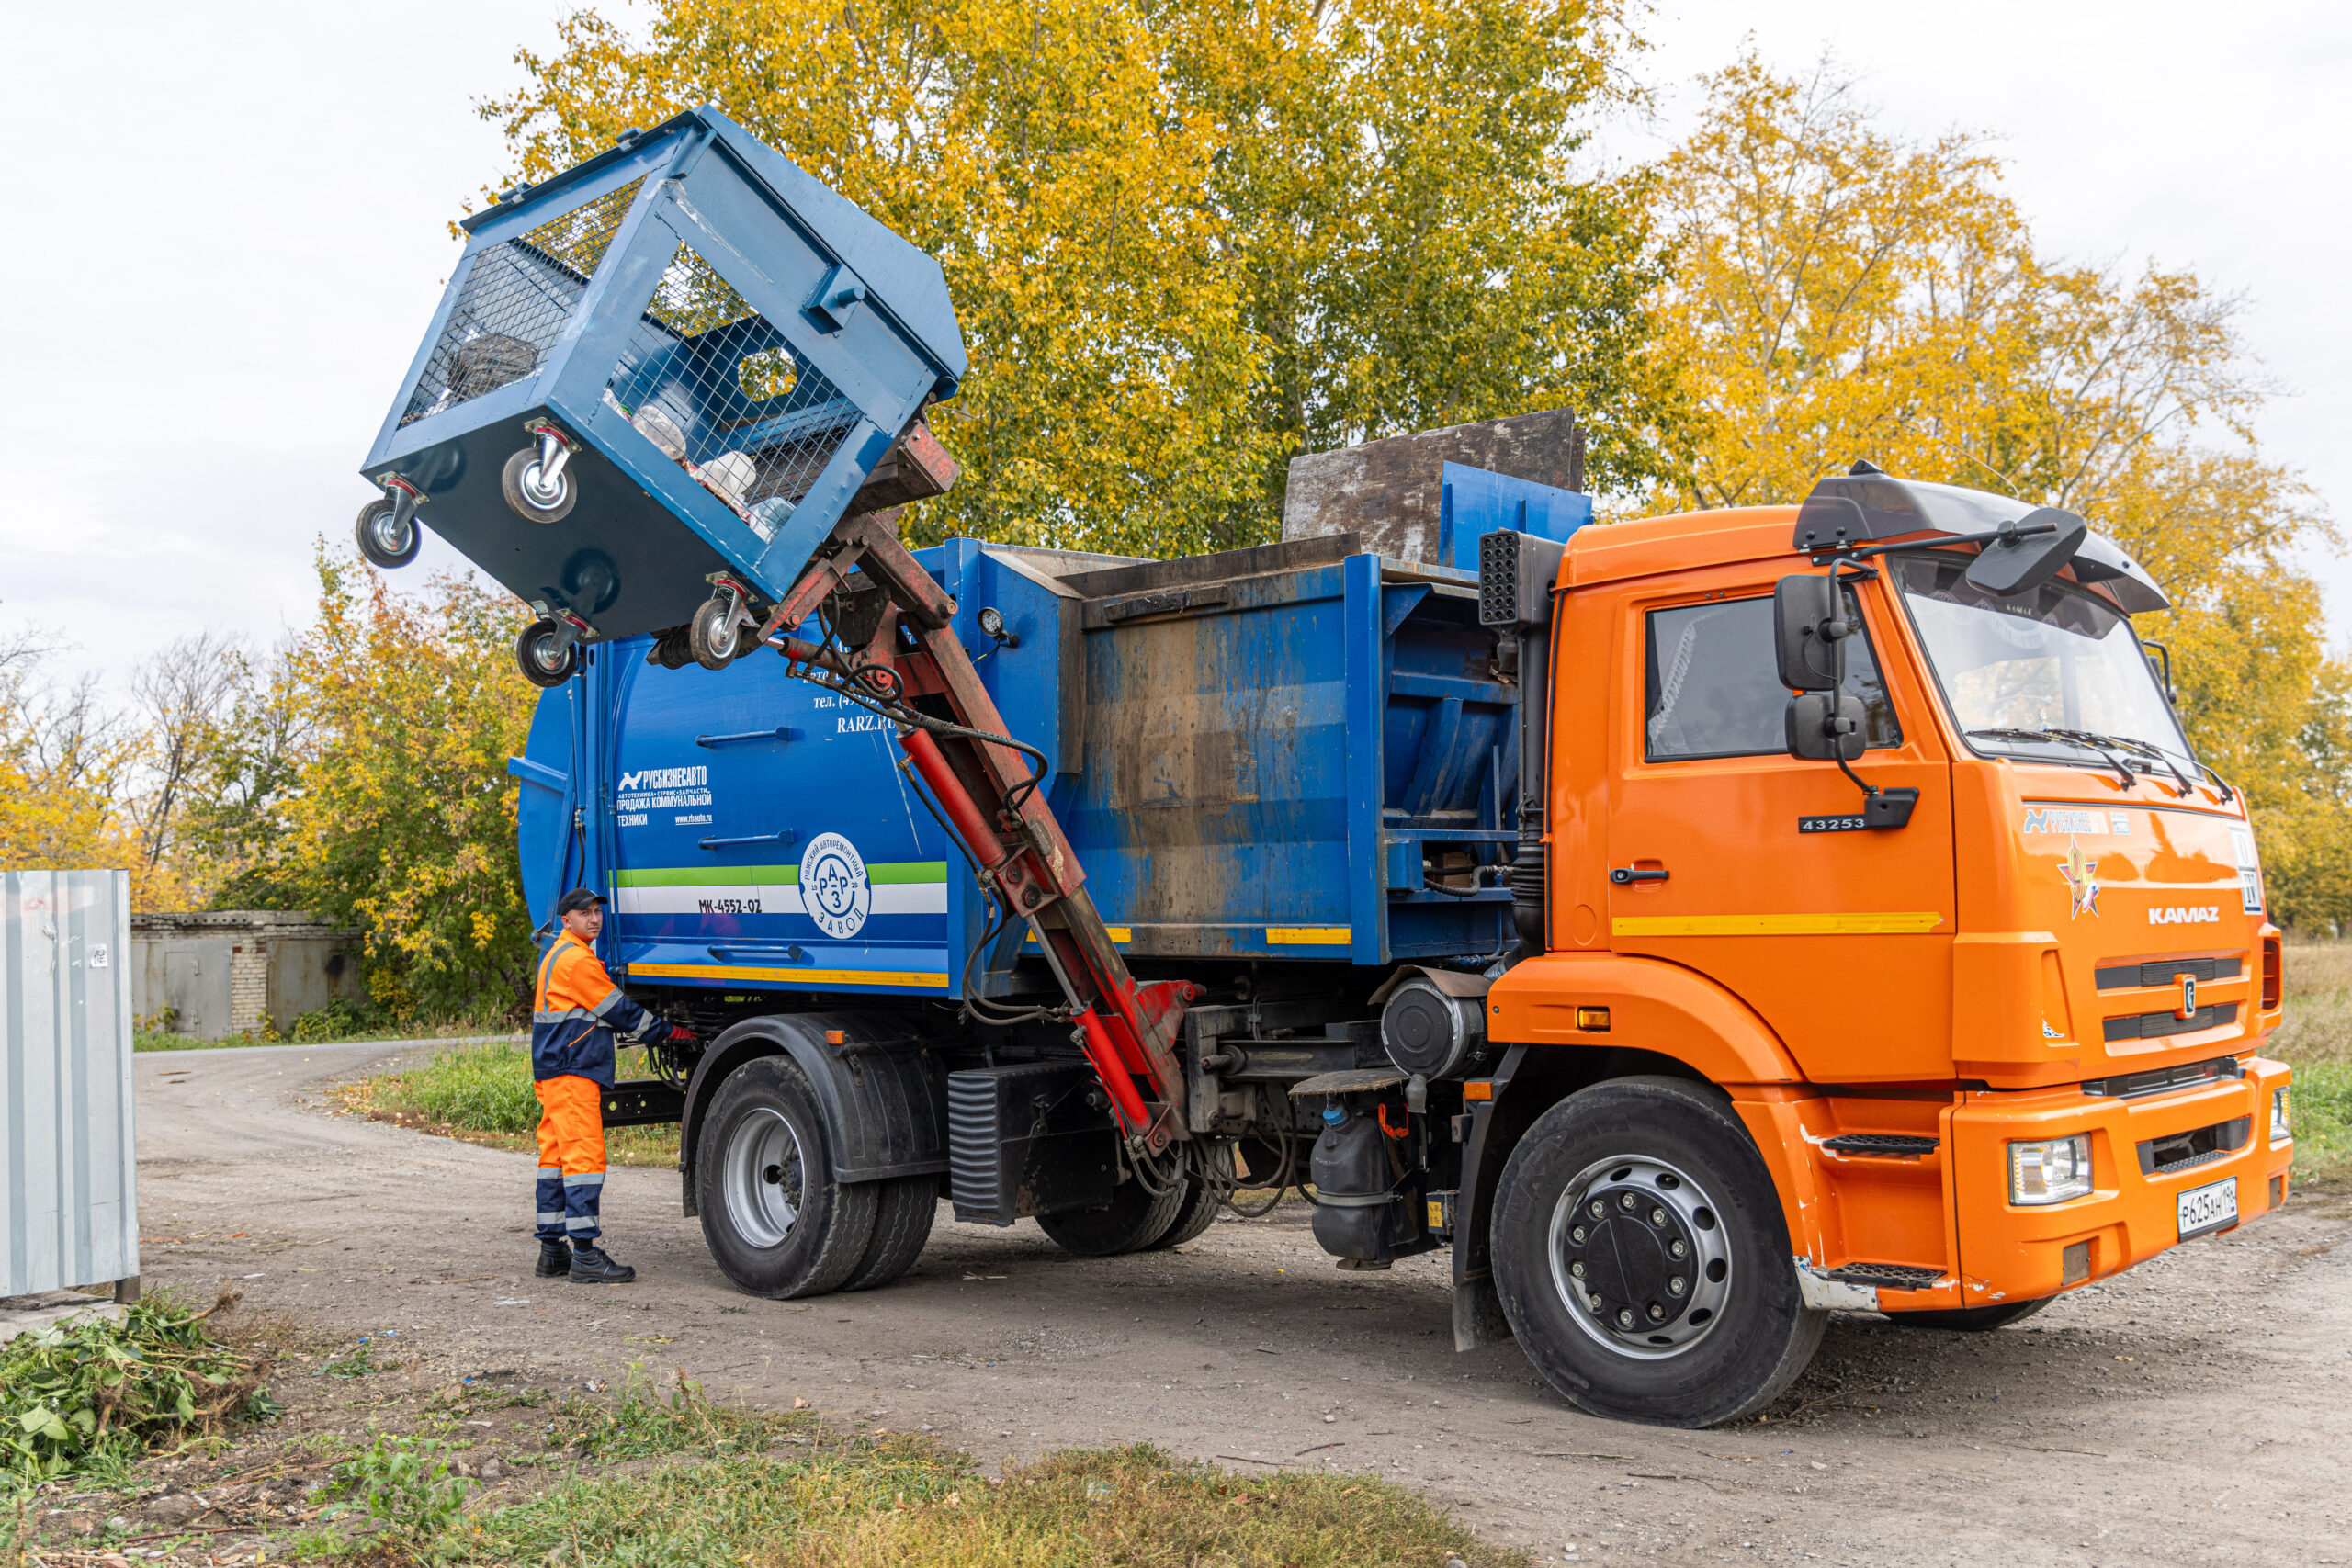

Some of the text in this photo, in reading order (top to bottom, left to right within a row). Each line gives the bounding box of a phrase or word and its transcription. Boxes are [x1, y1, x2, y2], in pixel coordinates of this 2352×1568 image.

[813, 696, 836, 709] тел.
[643, 765, 707, 790] РУСБИЗНЕСАВТО
[616, 790, 712, 812] ПРОДАЖА КОММУНАЛЬНОЙ
[617, 813, 649, 827] ТЕХНИКИ
[674, 814, 713, 826] www.rbauto.ru
[1802, 818, 1865, 830] 43253
[804, 839, 864, 880] РЯЖСКИЙ АВТОРЕМОНТНЫЙ
[818, 908, 865, 930] ЗАВОД
[2148, 905, 2220, 925] KAMAZ
